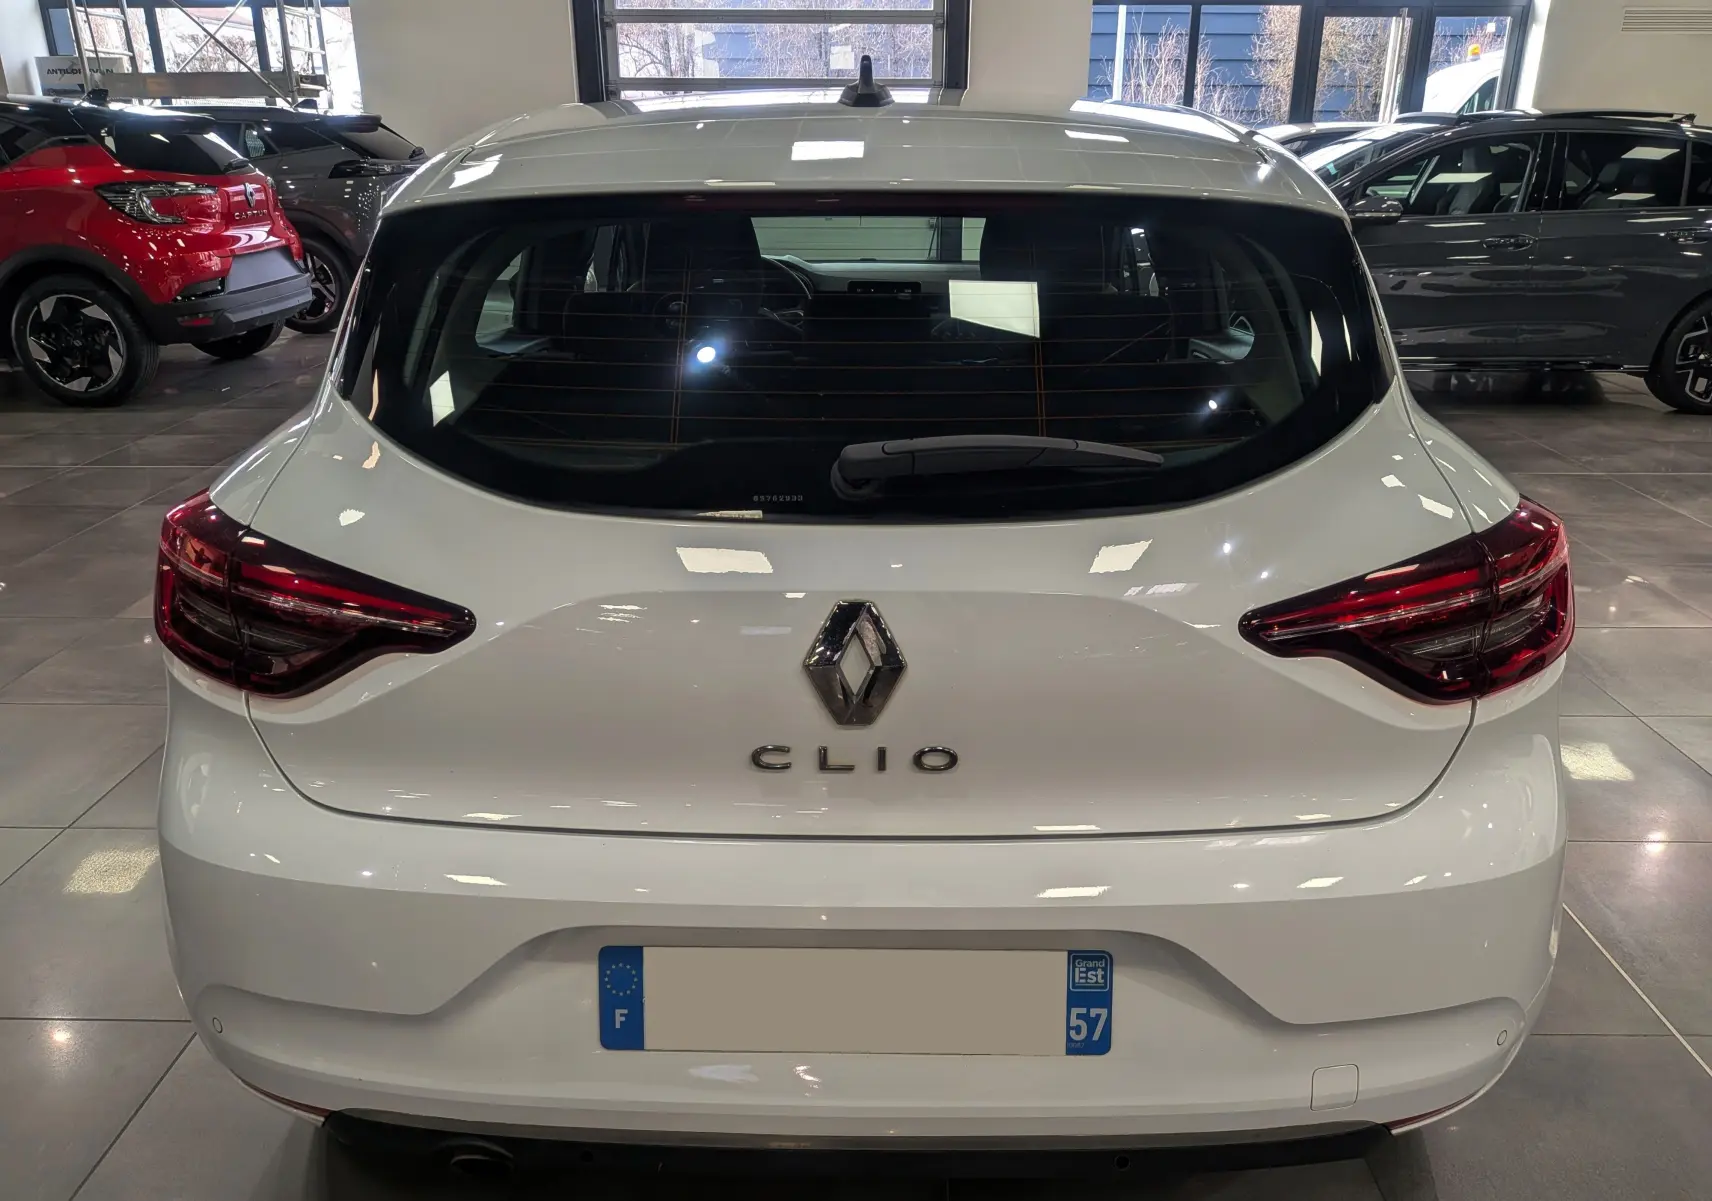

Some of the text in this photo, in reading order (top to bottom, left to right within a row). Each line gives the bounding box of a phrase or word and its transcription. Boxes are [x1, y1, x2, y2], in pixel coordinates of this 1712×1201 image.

[234, 209, 268, 220] CAPTUR
[751, 744, 958, 772] CLIO
[1075, 958, 1105, 968] Grand
[1074, 967, 1105, 984] Est
[615, 1008, 628, 1029] F
[1069, 1007, 1108, 1041] 57
